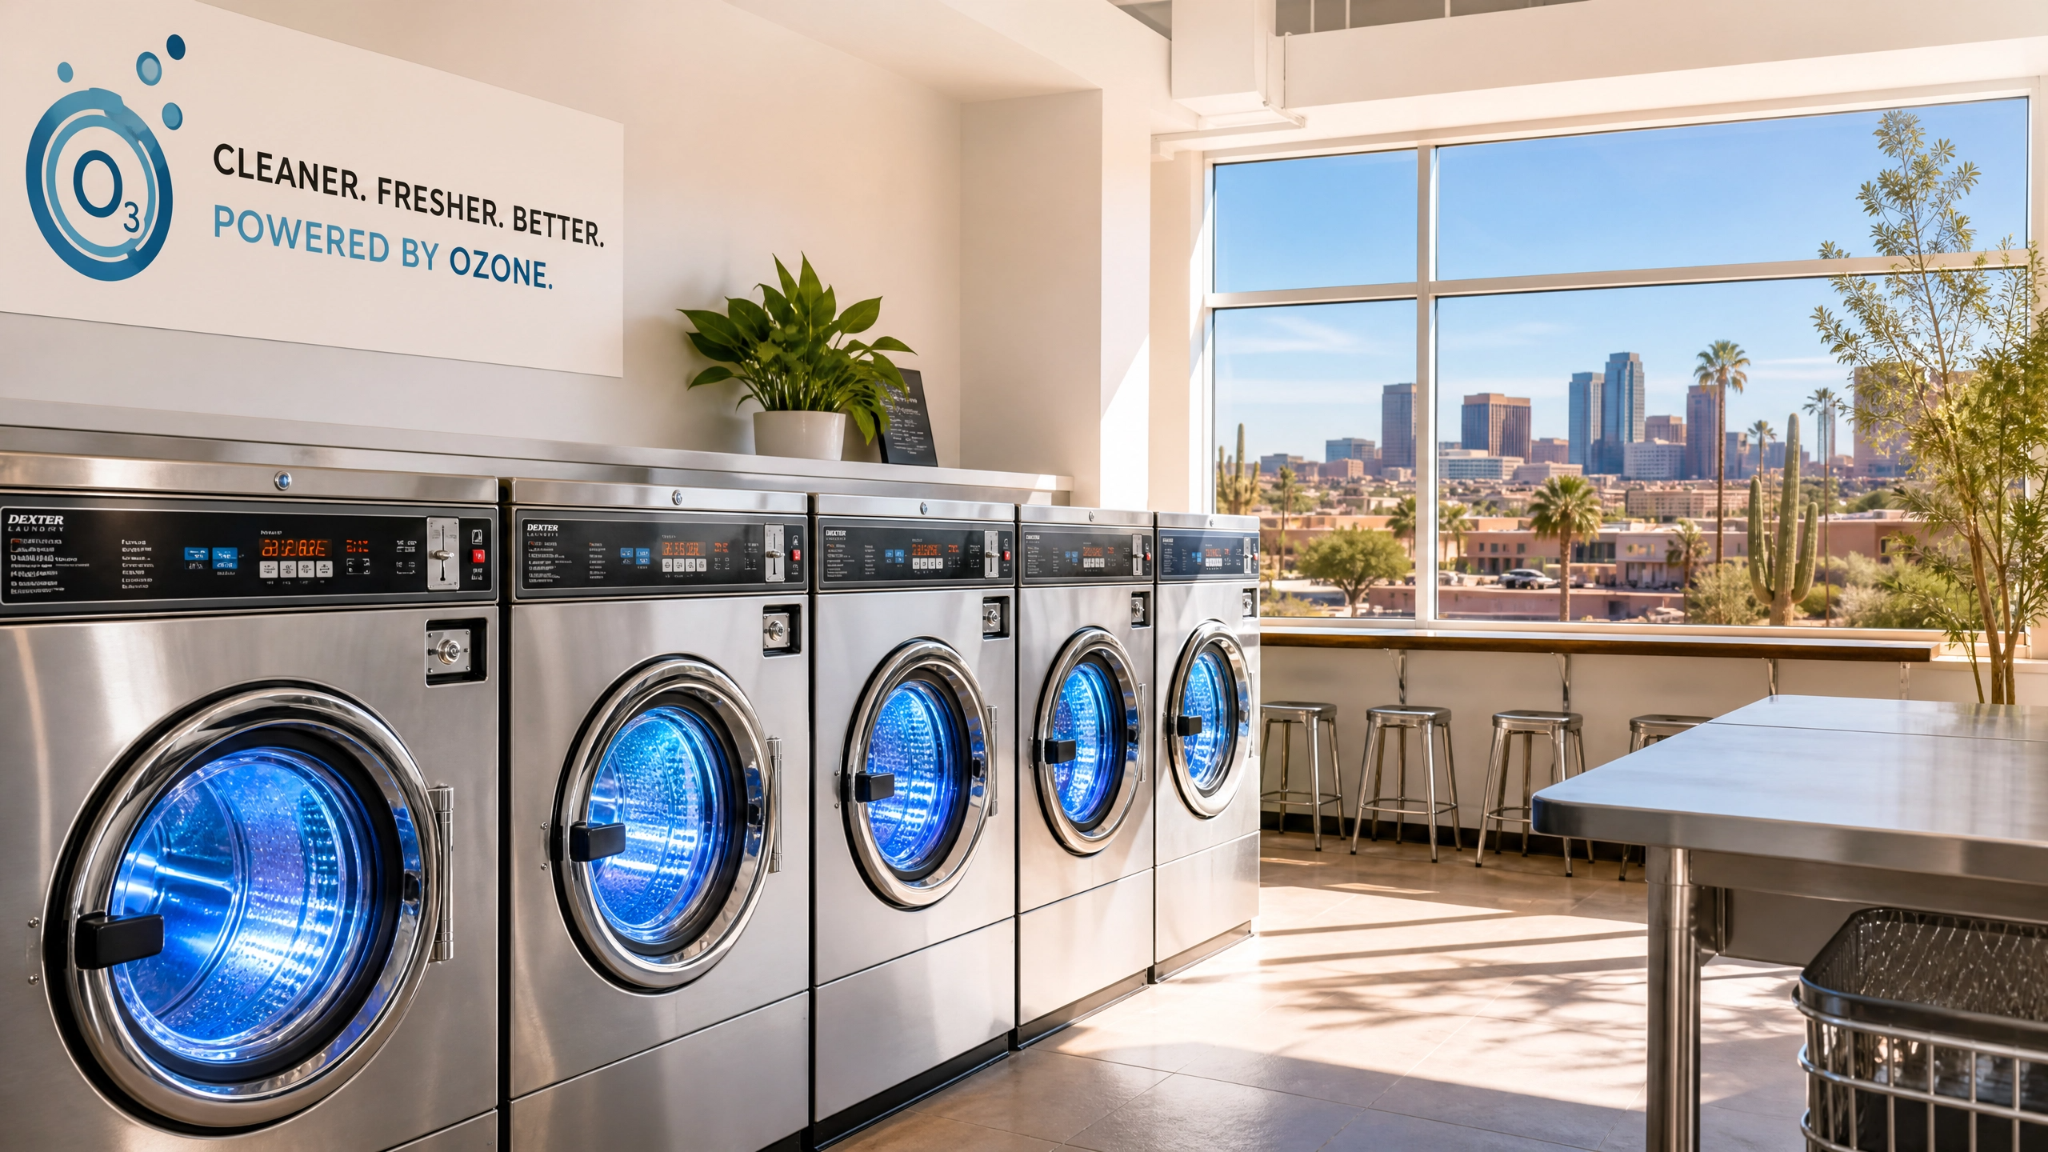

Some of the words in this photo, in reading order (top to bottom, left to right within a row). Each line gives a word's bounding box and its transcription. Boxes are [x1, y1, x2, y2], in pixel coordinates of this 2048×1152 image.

[213, 143, 367, 202] CLEANER.
[377, 177, 504, 229] FRESHER.
[513, 205, 605, 248] BETTER.
[214, 205, 390, 263] POWERED
[402, 238, 440, 271] BY
[449, 247, 553, 290] OZONE.
[8, 514, 64, 525] DEXTER
